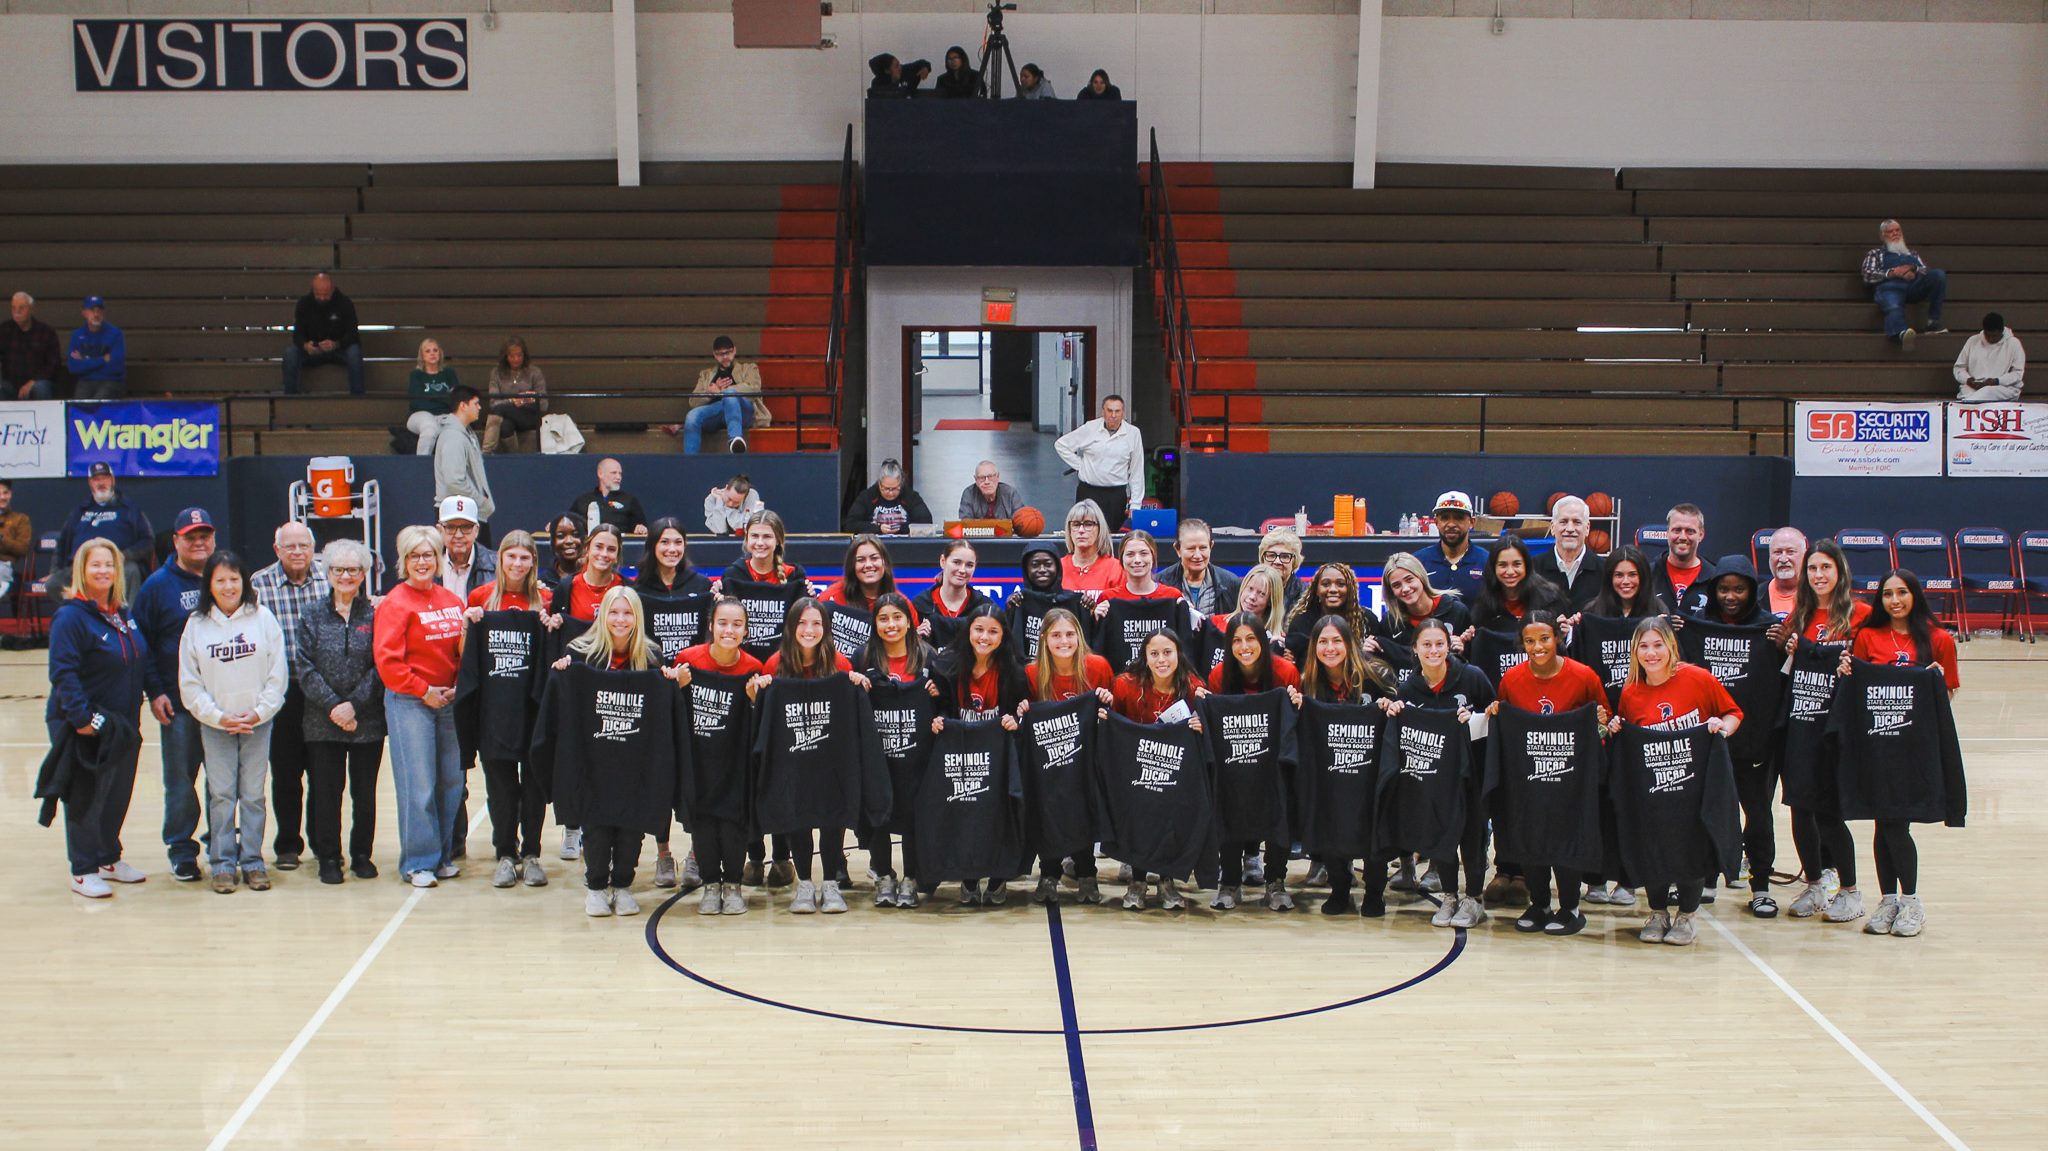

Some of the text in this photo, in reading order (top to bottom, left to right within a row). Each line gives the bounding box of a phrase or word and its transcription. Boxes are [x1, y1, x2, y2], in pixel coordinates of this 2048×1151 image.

[77, 21, 466, 88] VISITORS
[988, 303, 1012, 322] EXIT
[1857, 412, 1928, 427] SECURITY
[74, 418, 213, 463] Wrangler
[1857, 429, 1928, 441] STATE BANK
[316, 478, 333, 498] G
[457, 500, 464, 512] S
[962, 527, 994, 536] POSSESSION
[653, 612, 699, 626] SEMINOLE
[206, 643, 256, 661] Trojans
[1704, 637, 1750, 652] SEMINOLE
[1721, 650, 1749, 658] COLLEGE
[1867, 686, 1914, 699] SEMINOLE
[595, 709, 620, 717] WOMEN'S
[786, 715, 803, 723] STATE
[1032, 712, 1080, 736] SEMINOLE
[1222, 714, 1268, 729] SEMINOLE
[1035, 725, 1080, 742] STATE COLLEGE
[1037, 730, 1080, 746] WOMEN'S SOCCER
[1327, 724, 1375, 738] SEMINOLE
[1400, 726, 1446, 749] SEMINOLE
[1526, 731, 1575, 745] SEMINOLE
[1138, 738, 1185, 760] SEMINOLE
[1399, 739, 1442, 754] STATE COLLEGE
[1399, 745, 1441, 760] WOMEN'S SOCCER
[944, 752, 990, 767] SEMINOLE
[1136, 751, 1182, 766] STATE COLLEGE
[1136, 756, 1180, 771] WOMEN'S SOCCER
[1644, 755, 1662, 763] STATE
[1645, 757, 1692, 768] WOMEN'S SOCCER
